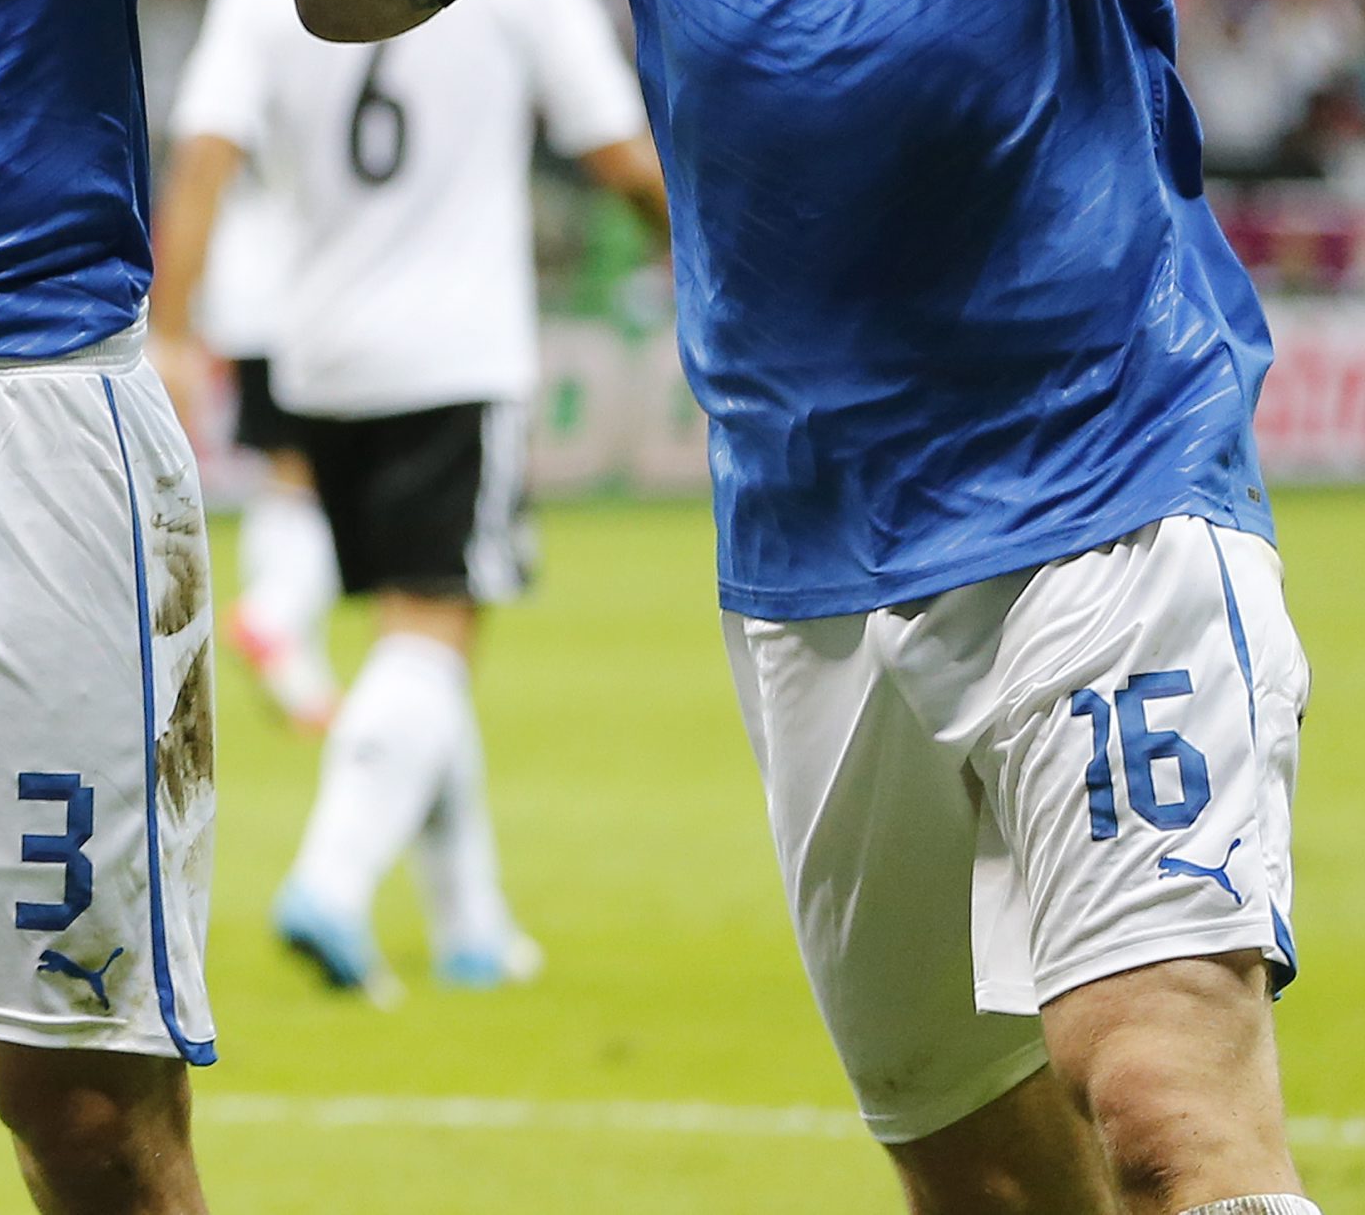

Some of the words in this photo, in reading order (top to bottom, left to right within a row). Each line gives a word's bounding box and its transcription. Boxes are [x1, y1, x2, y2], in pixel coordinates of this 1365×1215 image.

[351, 39, 405, 185] 6
[1070, 669, 1212, 842] 16
[15, 772, 95, 932] 3
